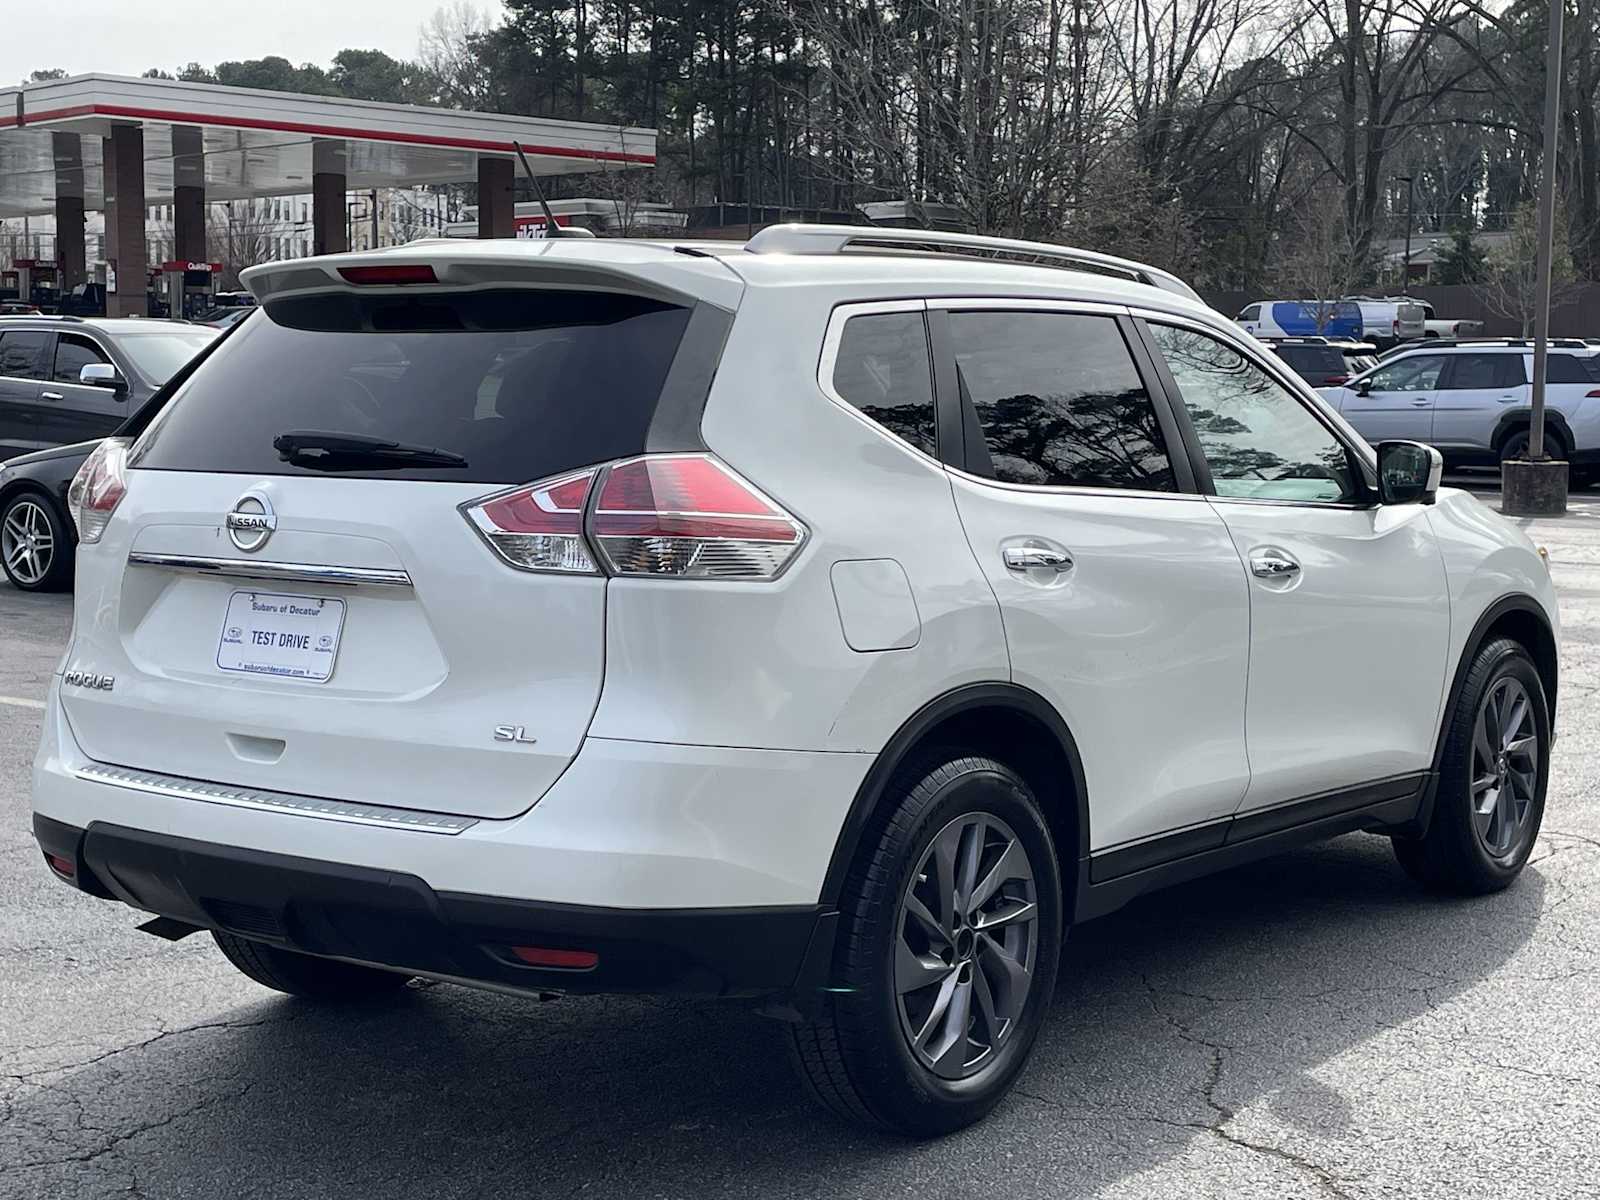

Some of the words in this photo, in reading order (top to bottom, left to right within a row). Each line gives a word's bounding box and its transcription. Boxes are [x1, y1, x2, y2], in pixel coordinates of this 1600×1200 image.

[229, 516, 268, 528] NISSAN
[252, 602, 278, 612] Subaru
[279, 605, 288, 613] of
[289, 605, 320, 616] Decatur
[252, 630, 277, 646] TEST
[279, 633, 310, 650] DRIVE
[64, 671, 115, 691] ROGUE
[494, 725, 537, 743] SL
